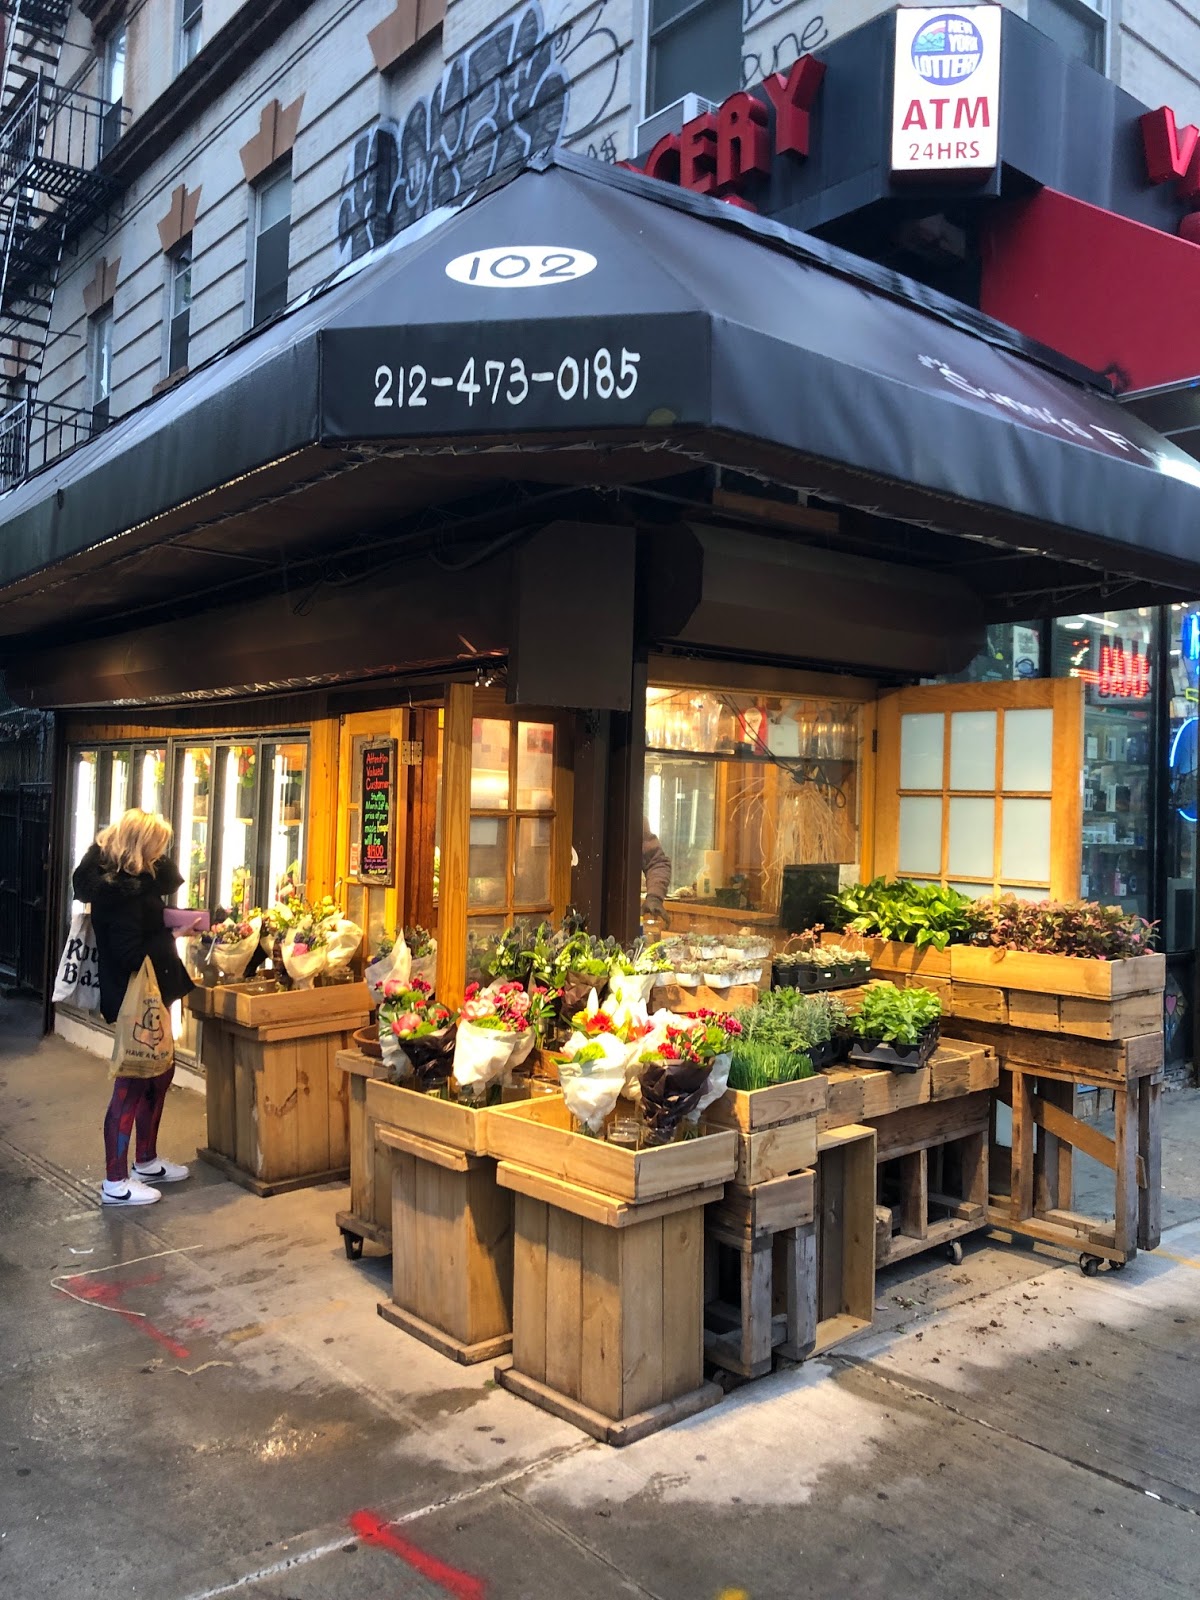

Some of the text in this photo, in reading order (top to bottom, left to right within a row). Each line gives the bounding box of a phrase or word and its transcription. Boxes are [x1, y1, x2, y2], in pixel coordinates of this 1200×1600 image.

[948, 19, 973, 34] NEW
[948, 33, 978, 53] YORK
[914, 53, 980, 78] LOTTERY
[901, 96, 990, 131] ATM
[909, 140, 980, 161] 24HRS
[469, 253, 577, 281] 102
[374, 346, 641, 408] 212-473-0185
[366, 752, 389, 764] Attention
[366, 764, 384, 777] Valued
